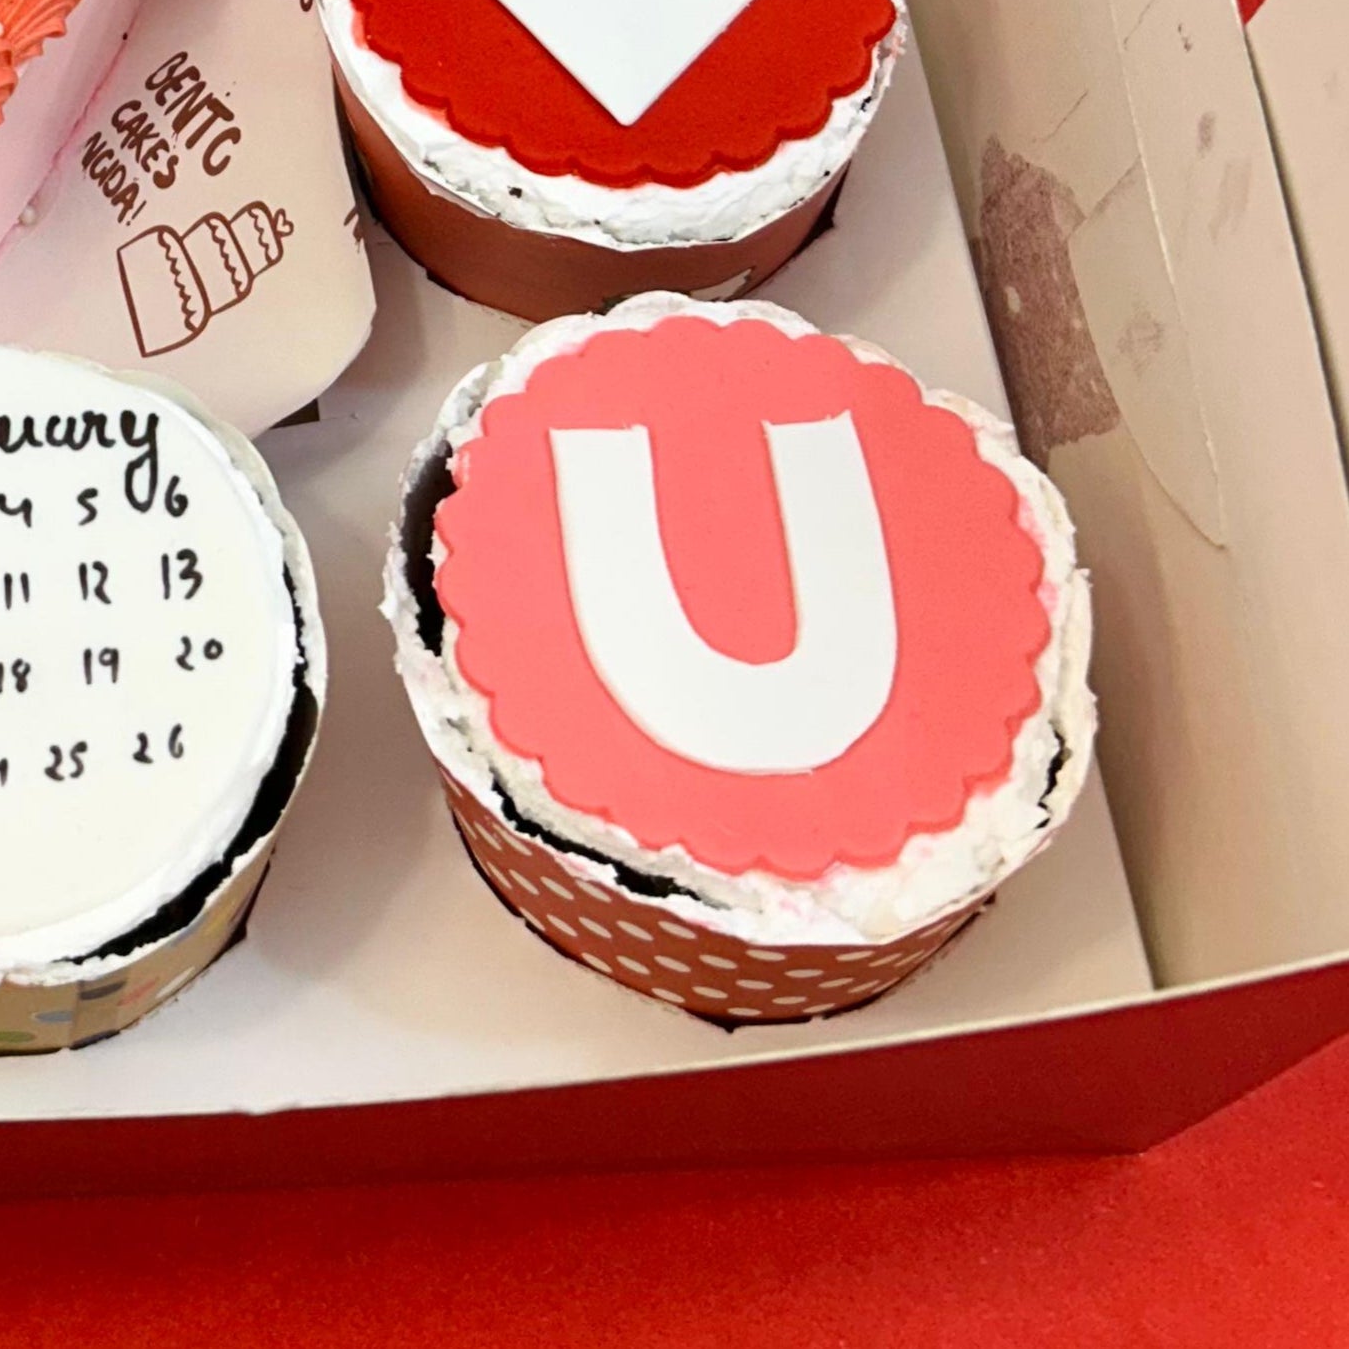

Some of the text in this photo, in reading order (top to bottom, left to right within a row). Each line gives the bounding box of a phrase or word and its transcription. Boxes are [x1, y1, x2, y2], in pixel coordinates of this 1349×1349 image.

[111, 99, 180, 190] CAKES
[76, 487, 99, 526] 5
[163, 475, 189, 518] 6
[3, 572, 31, 611] 11
[78, 560, 113, 605] 12
[161, 548, 204, 600] 13
[549, 409, 898, 776] U
[82, 647, 120, 685] 19
[175, 636, 224, 672] 20
[43, 741, 89, 782] 25
[131, 724, 185, 764] 26
